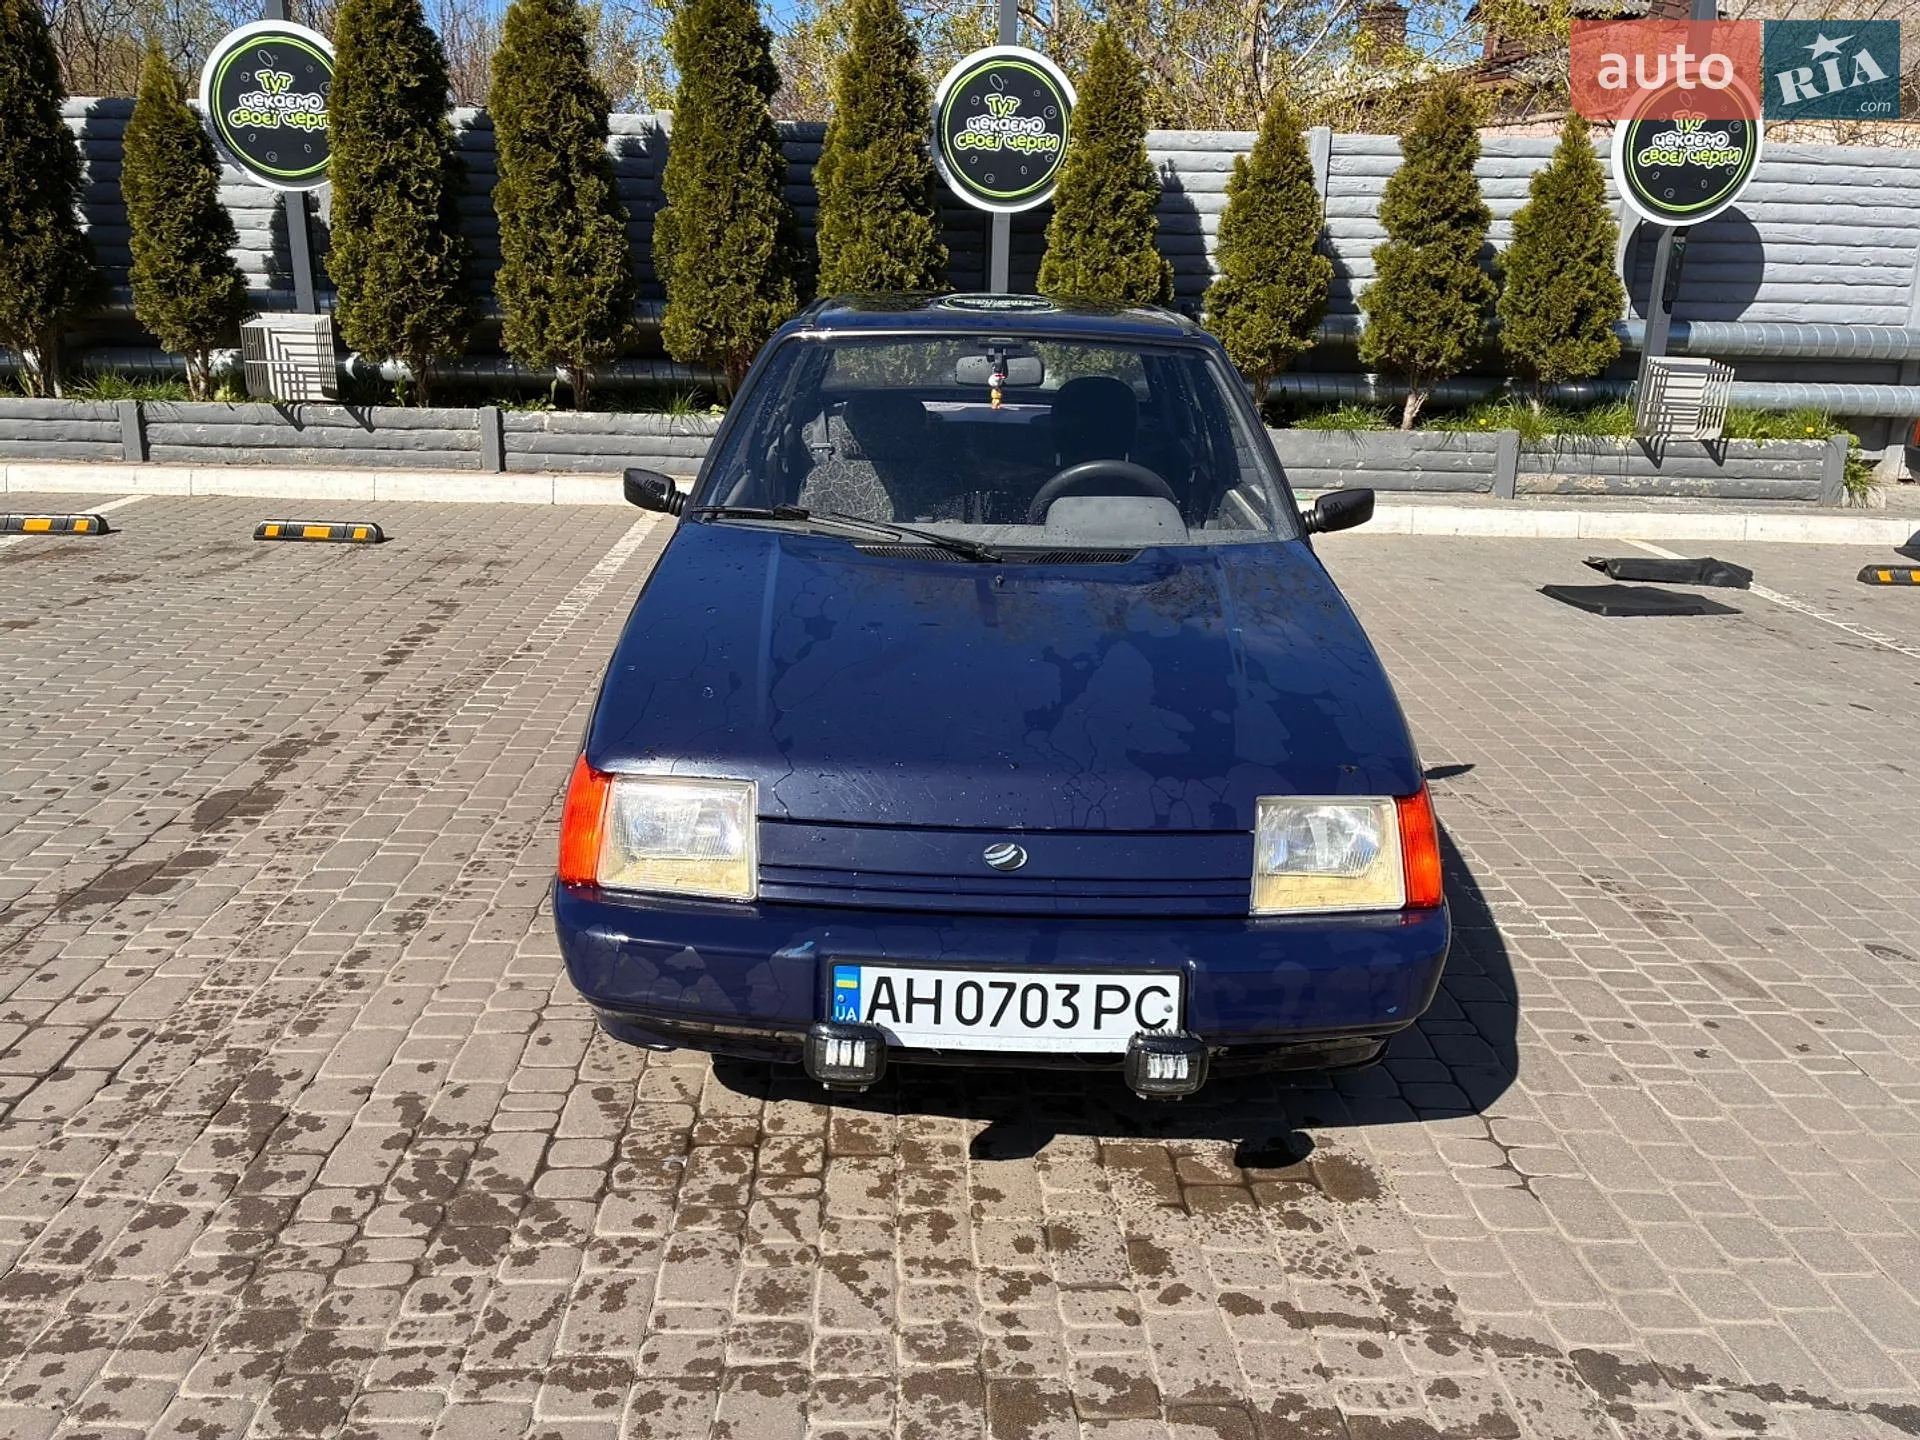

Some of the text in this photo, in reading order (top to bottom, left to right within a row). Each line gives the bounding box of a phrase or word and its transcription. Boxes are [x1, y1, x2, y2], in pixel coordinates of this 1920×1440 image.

[257, 71, 291, 94] Тут
[241, 94, 321, 109] чекаємо
[987, 96, 1018, 117] Тут
[231, 109, 331, 129] своєї черг
[968, 118, 1043, 133] чекаємо
[956, 132, 1057, 151] своєї черги
[1654, 133, 1727, 148] чекаємо
[1641, 148, 1741, 166] своєї черги
[834, 1005, 859, 1022] UA
